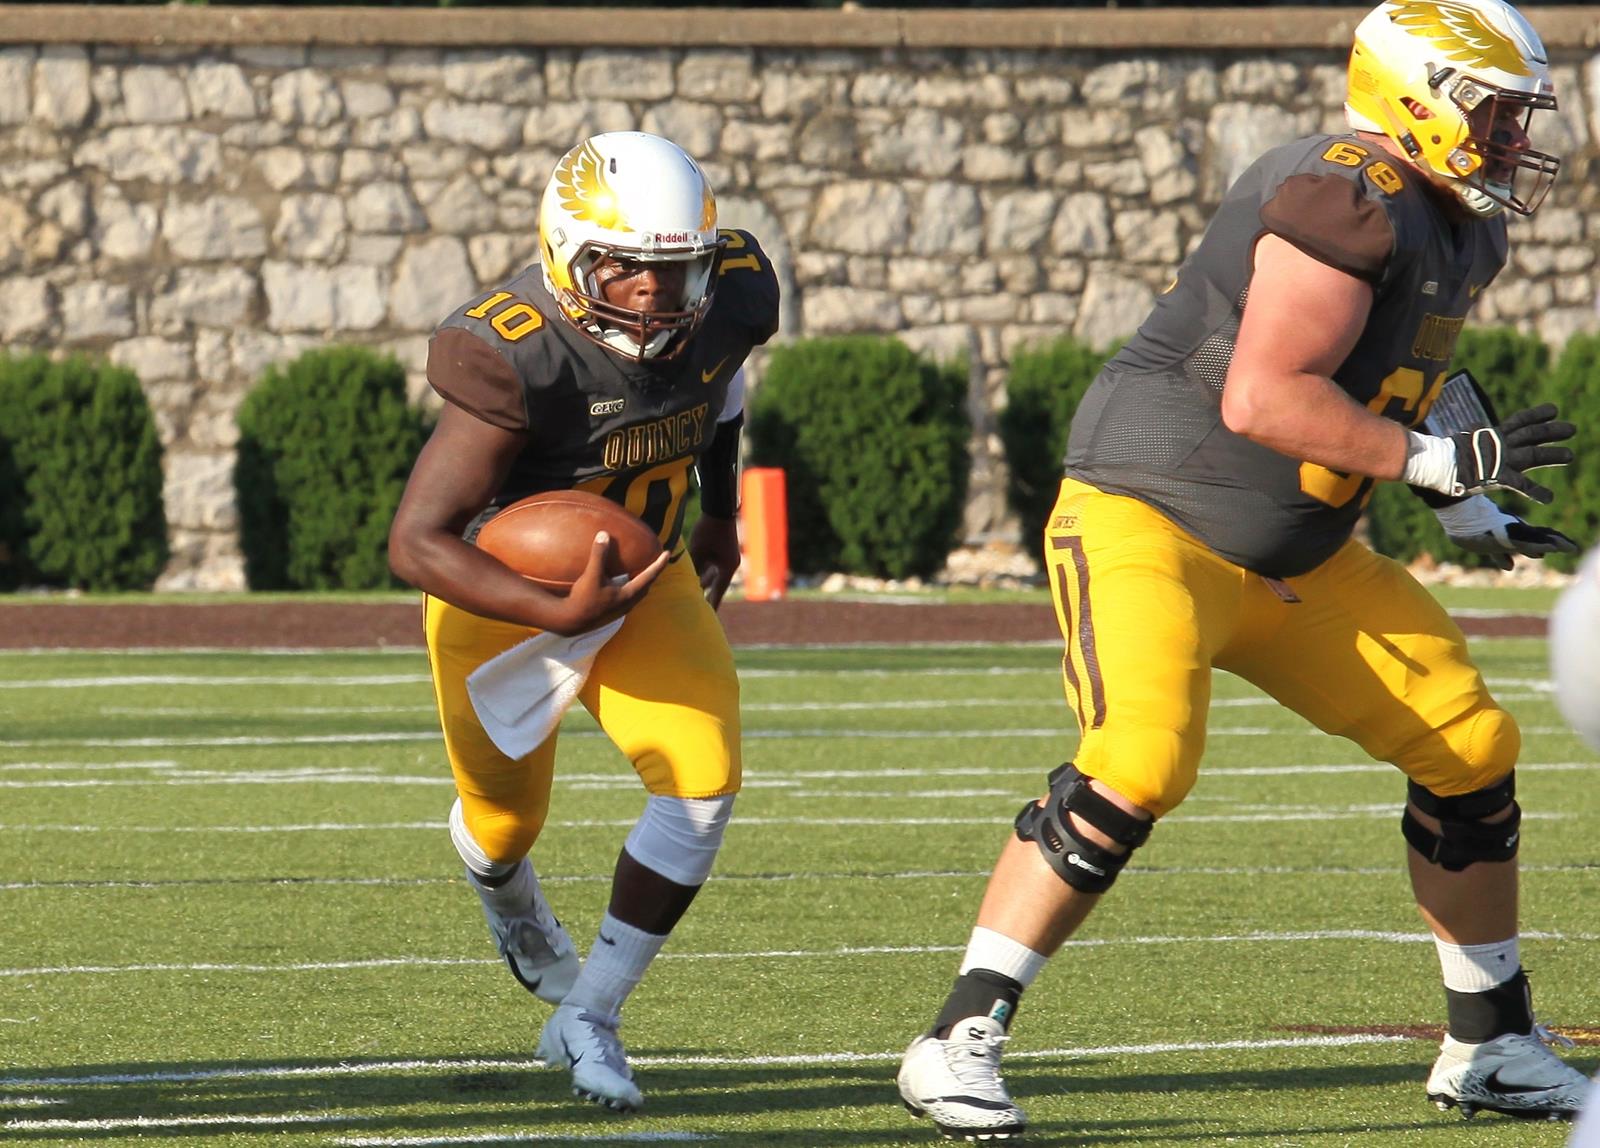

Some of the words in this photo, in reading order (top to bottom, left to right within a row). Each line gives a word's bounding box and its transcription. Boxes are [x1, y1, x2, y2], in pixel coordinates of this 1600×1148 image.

[1322, 142, 1405, 195] 68
[655, 232, 688, 243] Riddell
[464, 291, 544, 341] 10
[604, 402, 708, 470] QUINCY
